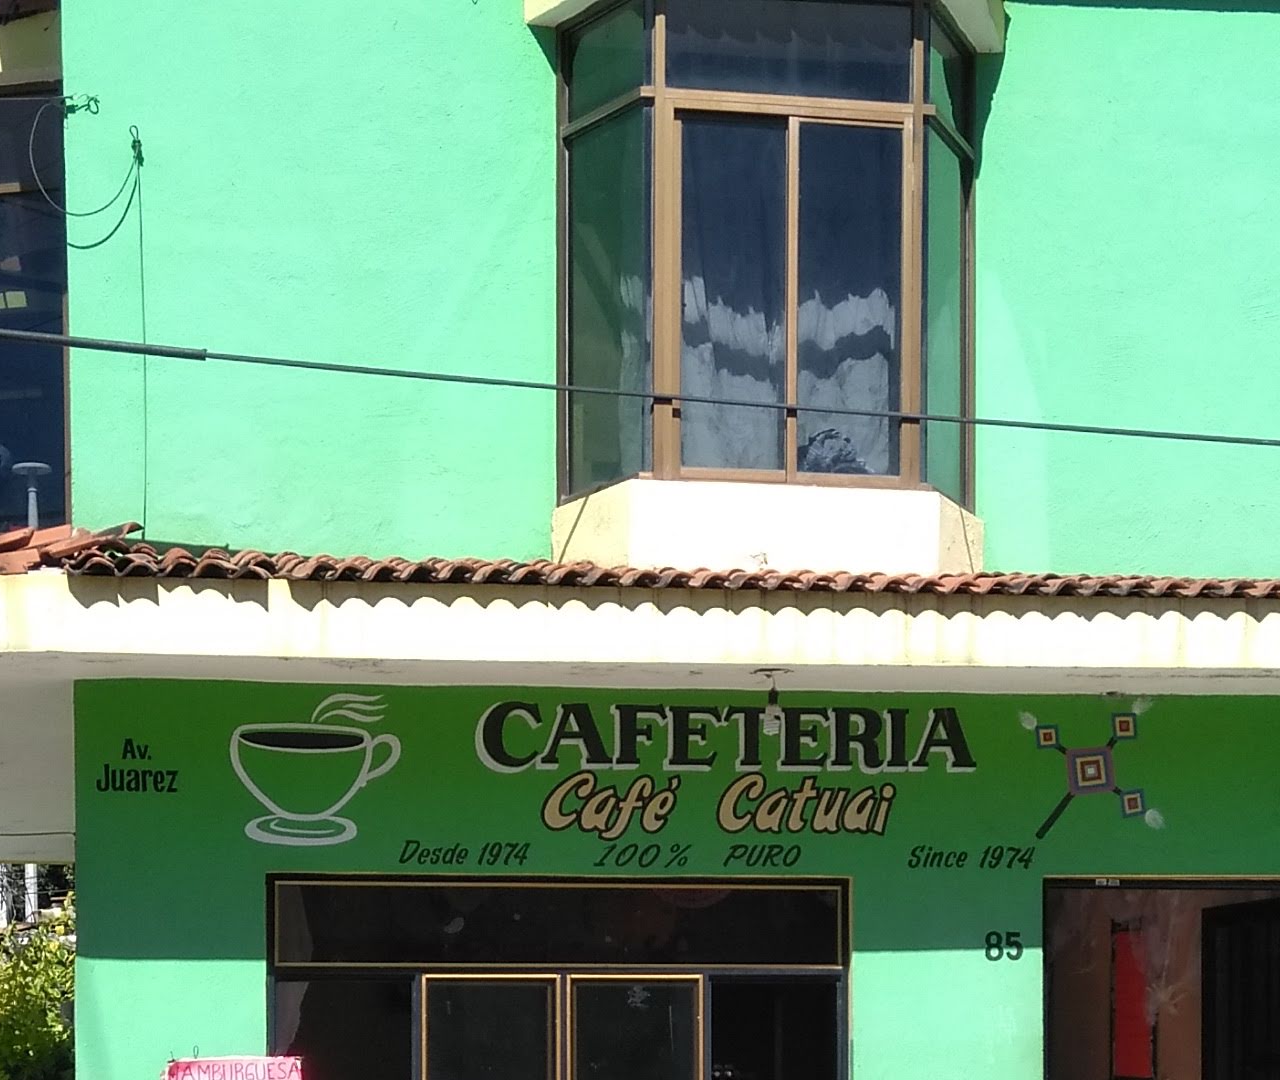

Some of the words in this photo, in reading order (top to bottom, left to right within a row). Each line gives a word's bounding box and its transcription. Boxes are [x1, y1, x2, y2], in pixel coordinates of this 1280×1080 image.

[121, 738, 152, 760] Av.
[475, 701, 977, 774] CAFETERIA
[96, 764, 179, 793] Juarez
[541, 769, 681, 841] Café
[716, 771, 896, 835] Catuai
[399, 840, 468, 866] Desde
[477, 842, 530, 866] 1974
[593, 842, 692, 868] 100%
[723, 843, 802, 869] PURO
[907, 845, 968, 870] Since
[978, 846, 1035, 870] 1974
[984, 931, 1024, 961] 85
